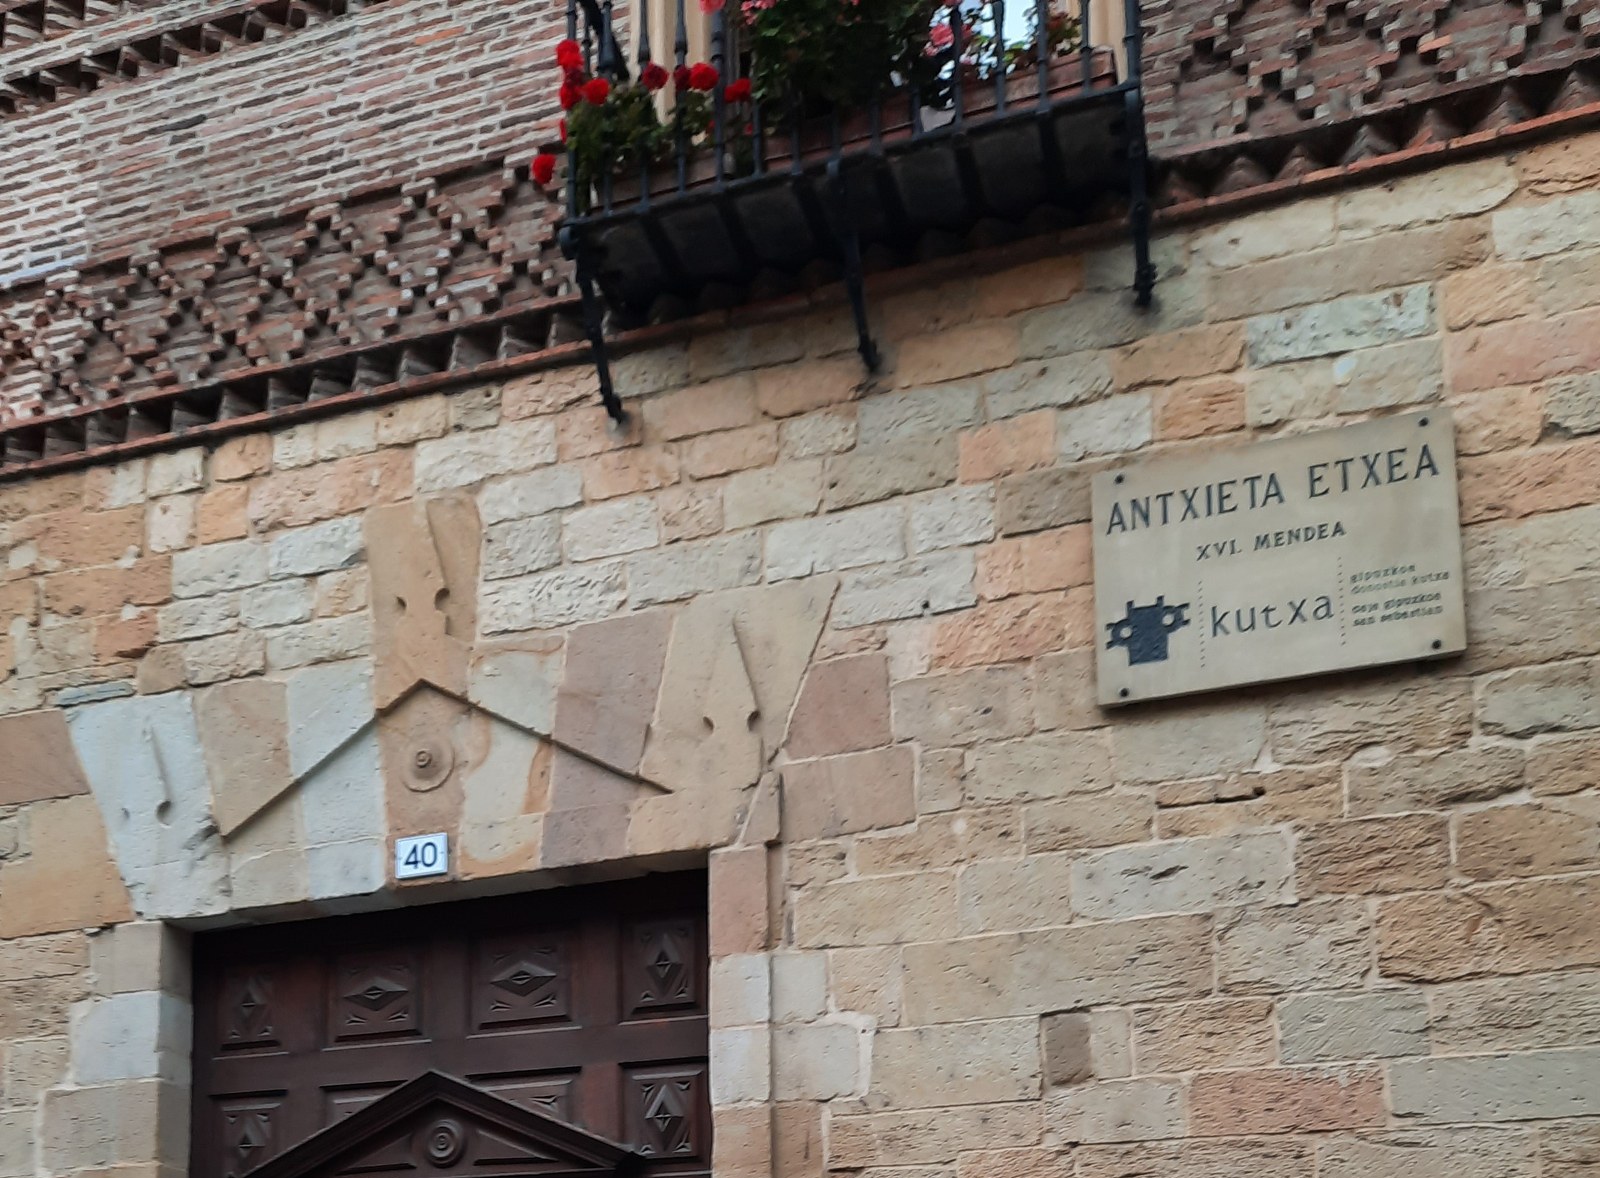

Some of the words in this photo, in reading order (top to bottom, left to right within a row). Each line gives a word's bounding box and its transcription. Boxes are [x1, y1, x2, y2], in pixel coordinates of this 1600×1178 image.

[1105, 472, 1286, 535] ANTXIETA
[1307, 443, 1440, 499] ETXEA
[1196, 542, 1242, 562] XVI.
[1253, 520, 1347, 552] MENDEA
[1210, 594, 1335, 638] kutxa
[403, 842, 438, 869] 40
